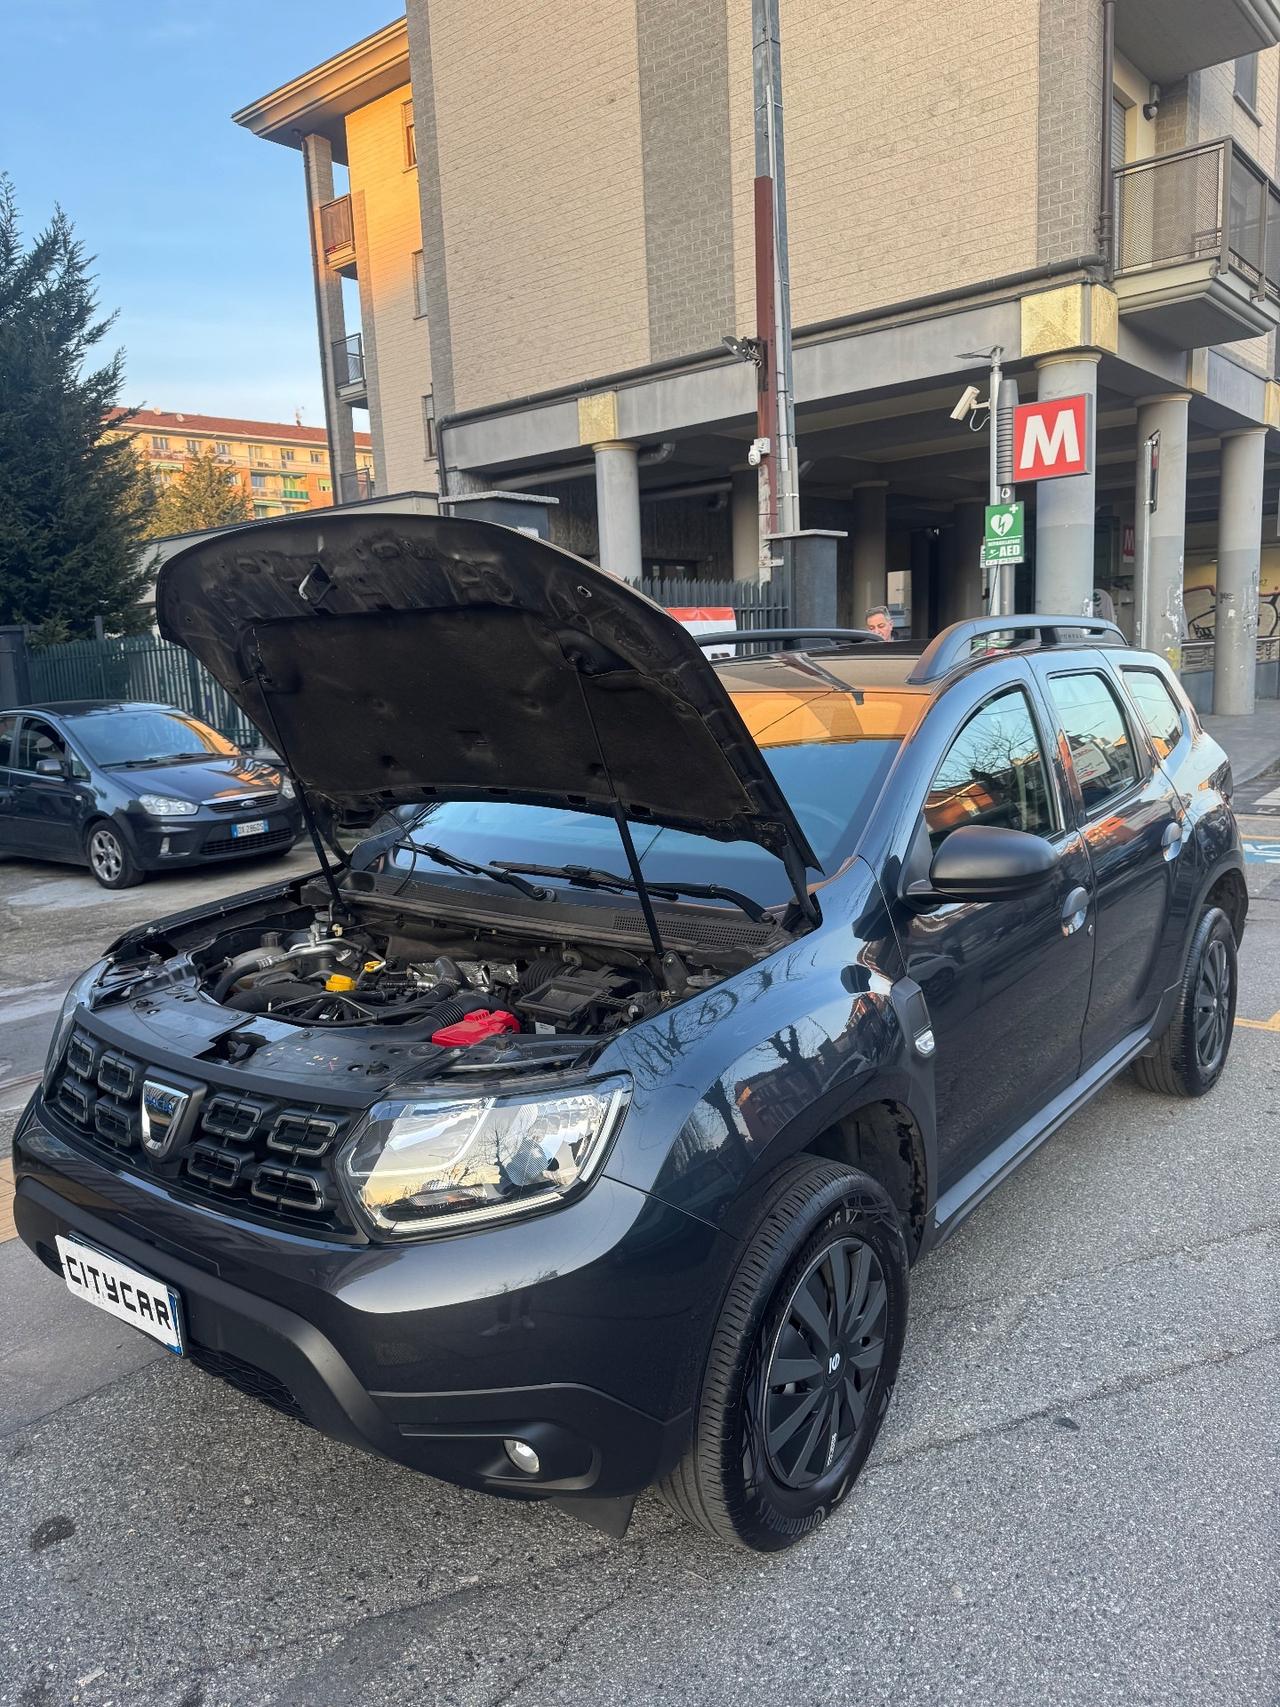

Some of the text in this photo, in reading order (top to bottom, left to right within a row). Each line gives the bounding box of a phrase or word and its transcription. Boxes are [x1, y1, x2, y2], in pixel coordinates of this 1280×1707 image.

[1020, 409, 1081, 469] M
[999, 544, 1020, 558] AED
[66, 1255, 172, 1330] CITYCAR
